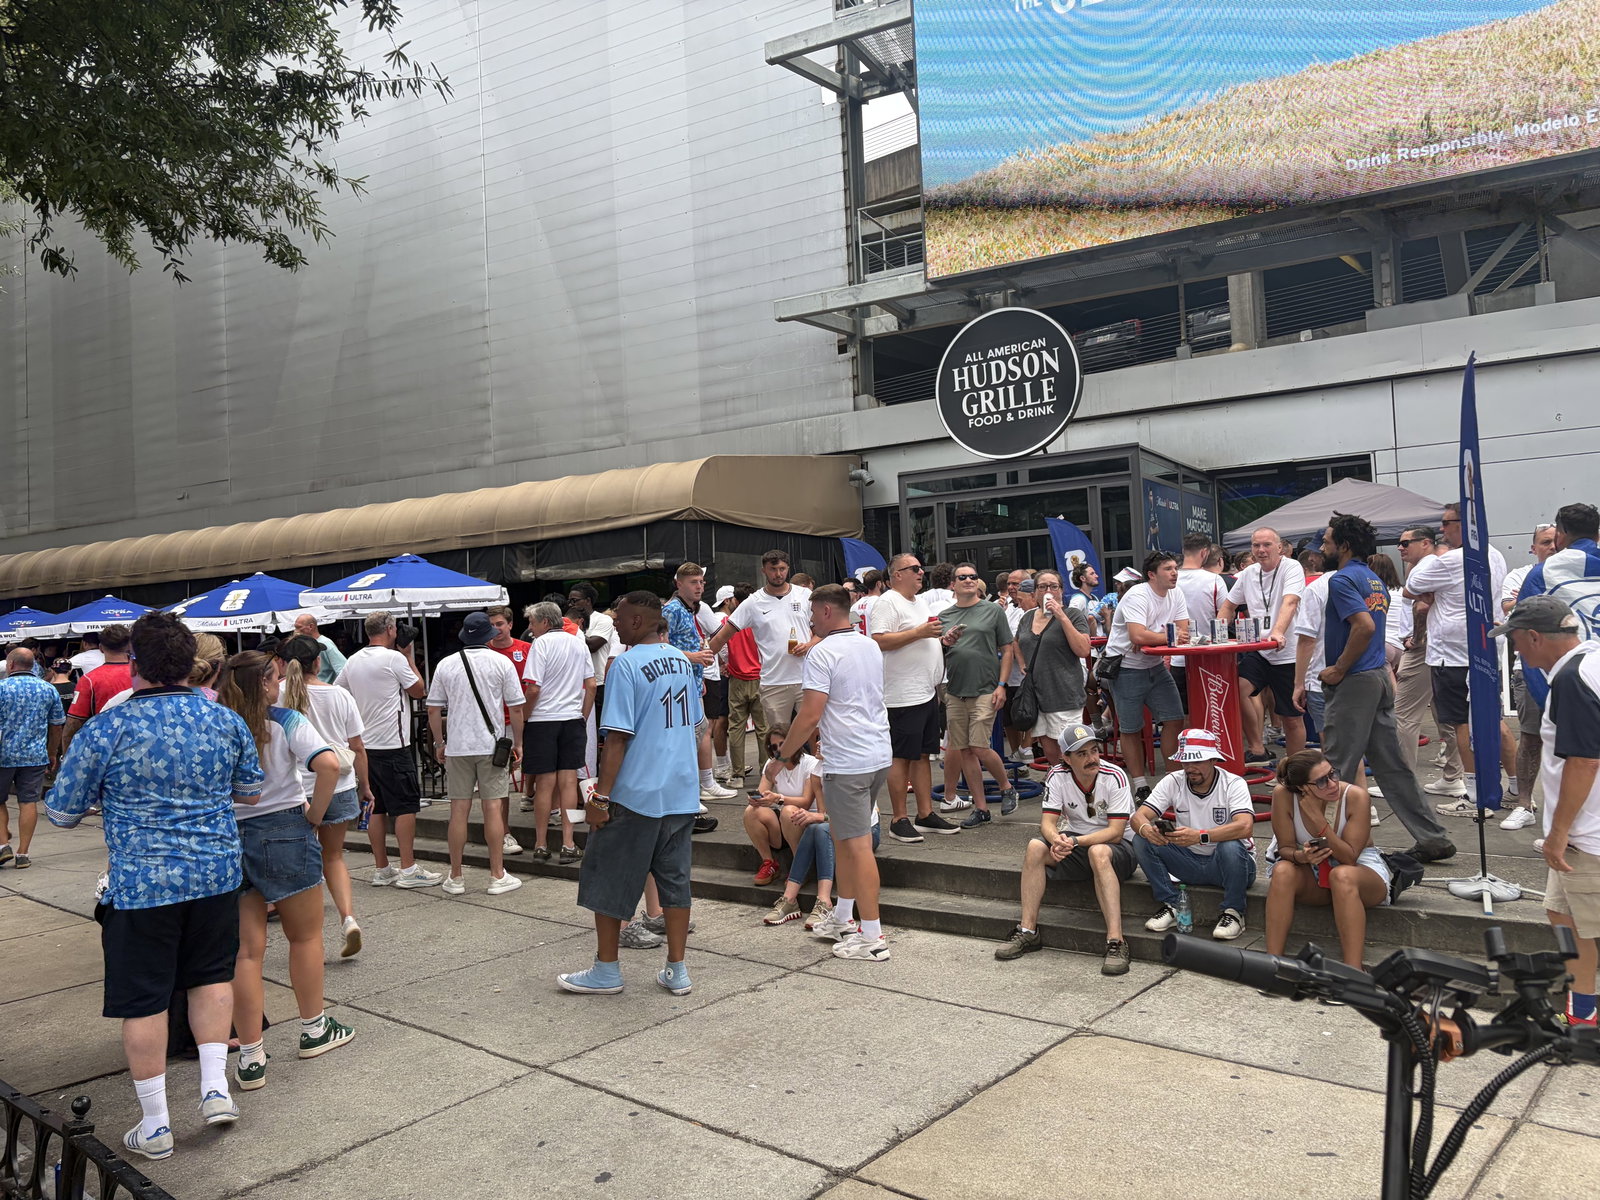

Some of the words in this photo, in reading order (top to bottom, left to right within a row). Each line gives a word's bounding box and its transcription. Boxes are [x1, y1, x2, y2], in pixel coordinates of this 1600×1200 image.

[1345, 150, 1392, 171] Drink
[1397, 129, 1507, 162] Responsibly.
[1514, 114, 1580, 138] Modelo
[964, 351, 984, 363] ALL
[987, 337, 1047, 359] AMERICAN
[952, 347, 1060, 392] HUDSON
[962, 377, 1057, 417] GRILLE
[968, 414, 1002, 428] FOOD
[1006, 412, 1014, 422] &
[1018, 404, 1055, 420] DRINK
[1186, 517, 1213, 534] MATCHDAY
[1191, 504, 1207, 521] MAKE
[349, 593, 373, 601] ULTRA
[229, 617, 254, 626] ULTRA
[640, 656, 692, 684] BICHETT
[660, 684, 690, 729] 11
[1207, 673, 1224, 753] Budweiser
